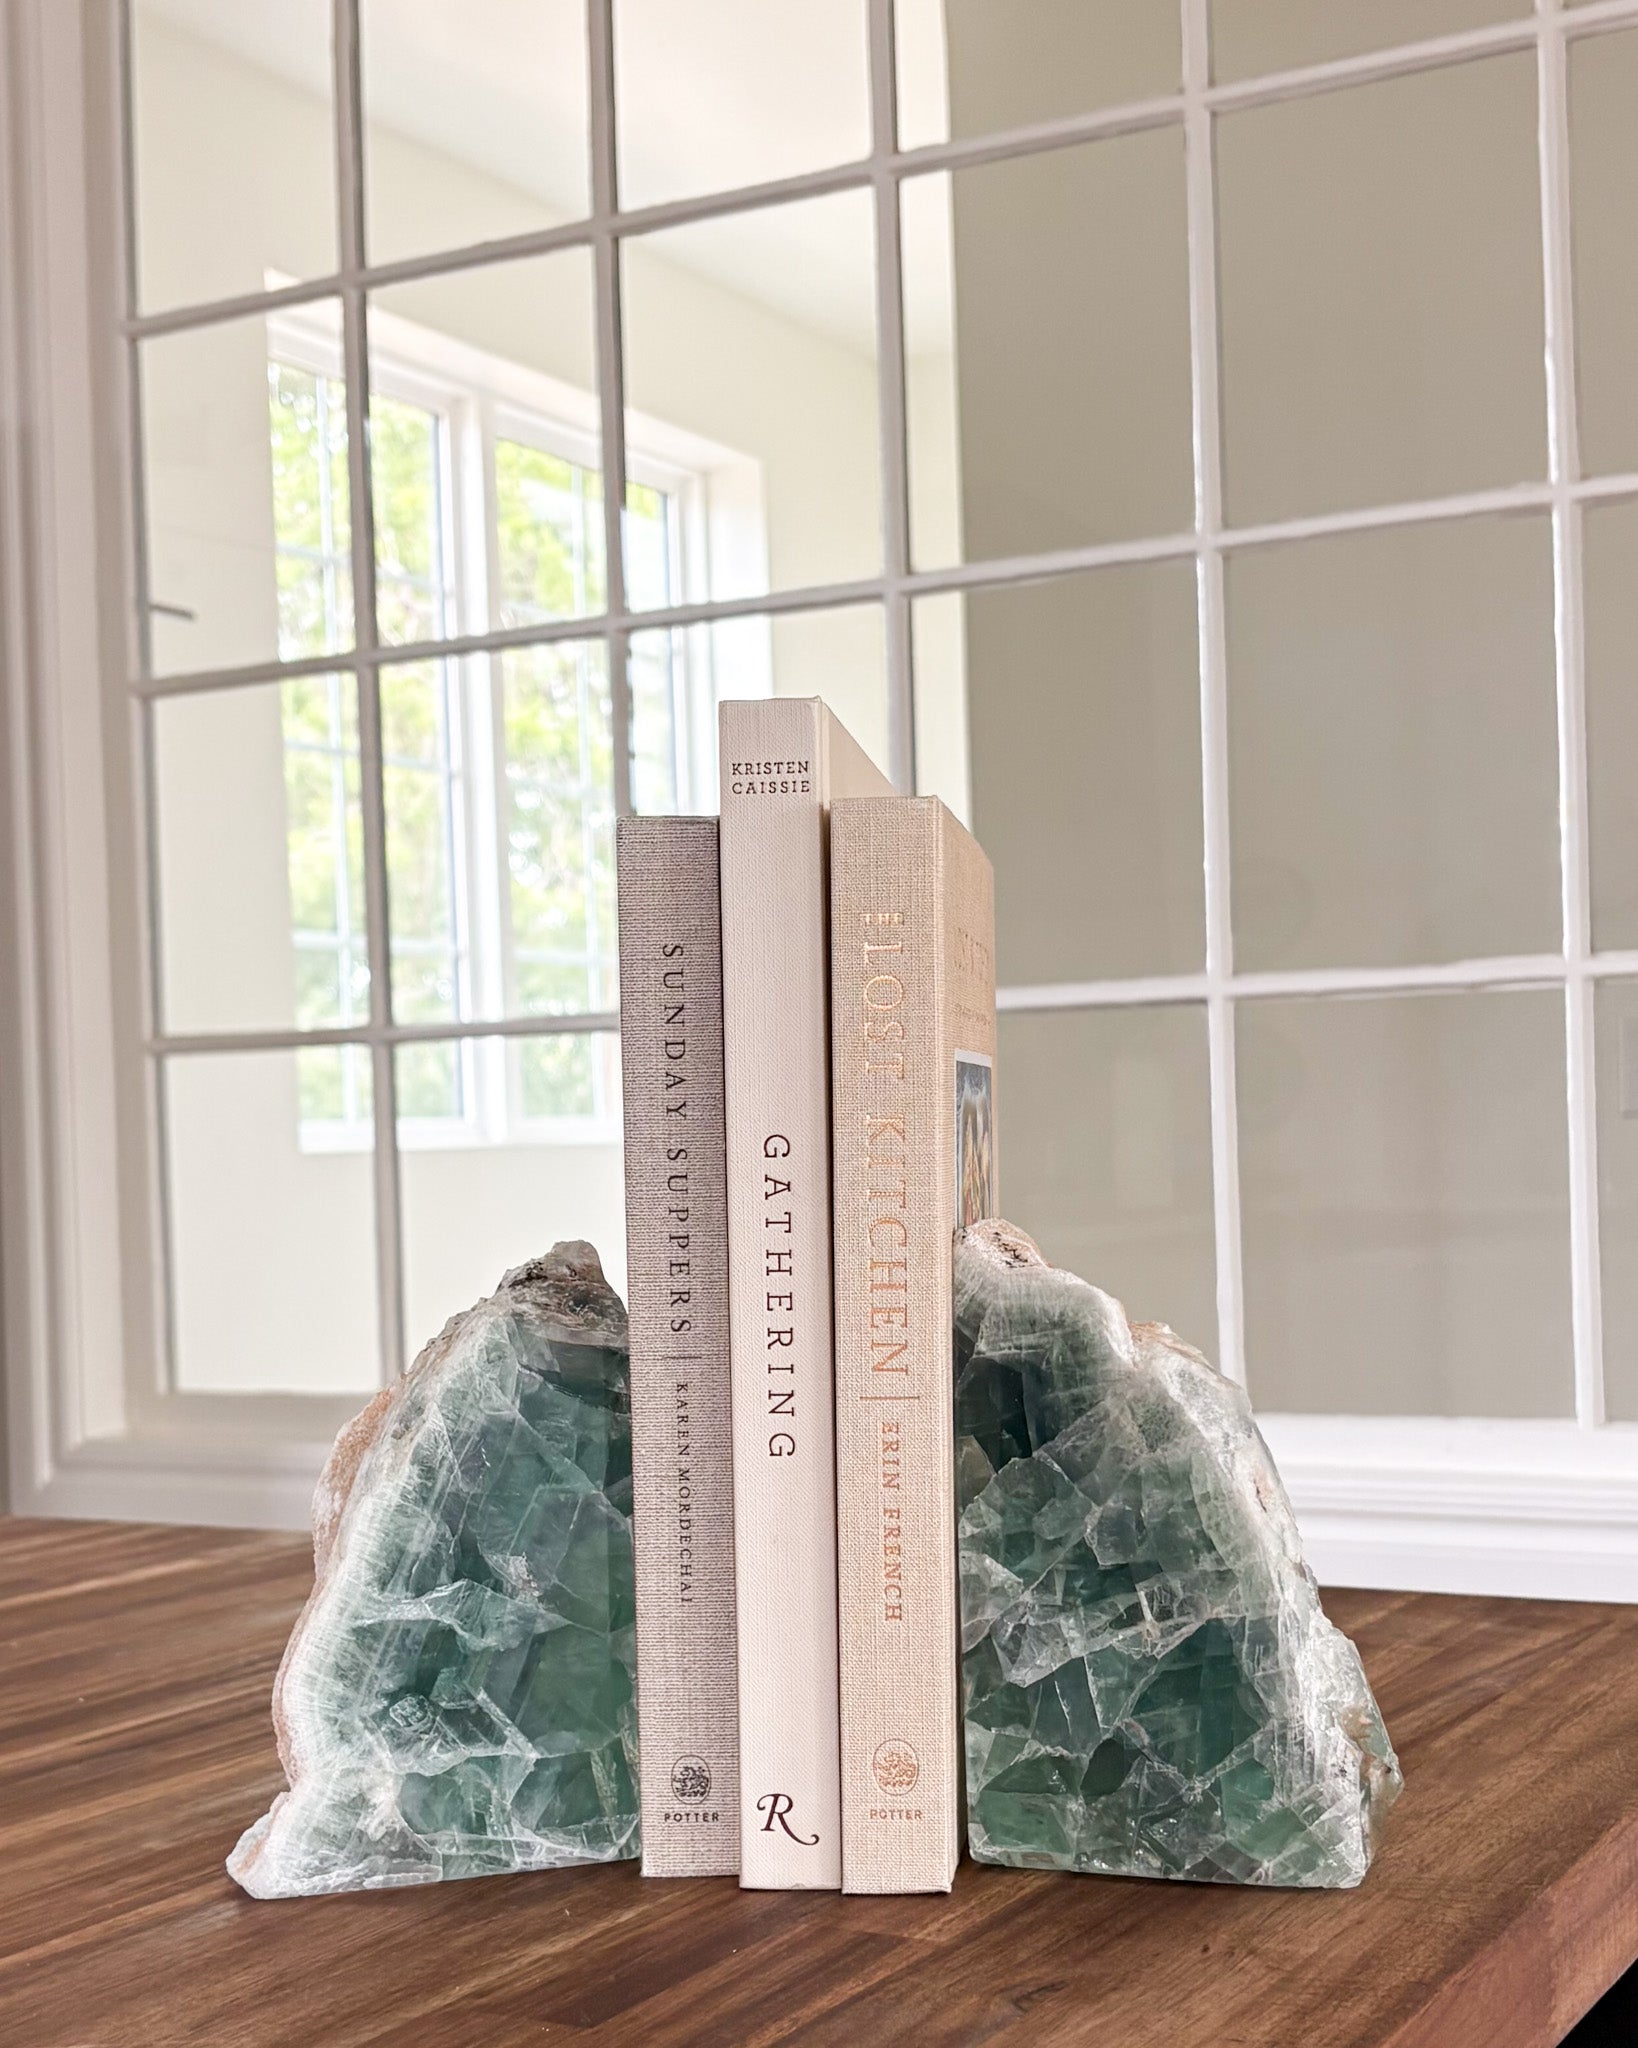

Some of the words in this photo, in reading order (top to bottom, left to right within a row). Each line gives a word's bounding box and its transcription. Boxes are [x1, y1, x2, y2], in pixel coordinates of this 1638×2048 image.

[731, 760, 810, 776] KRISTEN
[731, 780, 811, 795] CAISSIE
[859, 911, 904, 926] THE
[662, 942, 688, 1119] SUNDAY
[863, 941, 906, 1080] LOST
[666, 1147, 692, 1334] SUPPERS
[865, 1113, 909, 1376] KITCHEN
[763, 1134, 796, 1458] GATHERING
[675, 1383, 690, 1457] KAREN
[881, 1420, 900, 1492] ERIN
[678, 1468, 693, 1604] MORDECHAI
[882, 1507, 903, 1622] FRENCH
[663, 1811, 720, 1823] POTTER
[756, 1792, 820, 1846] R
[869, 1809, 923, 1821] POTTER
